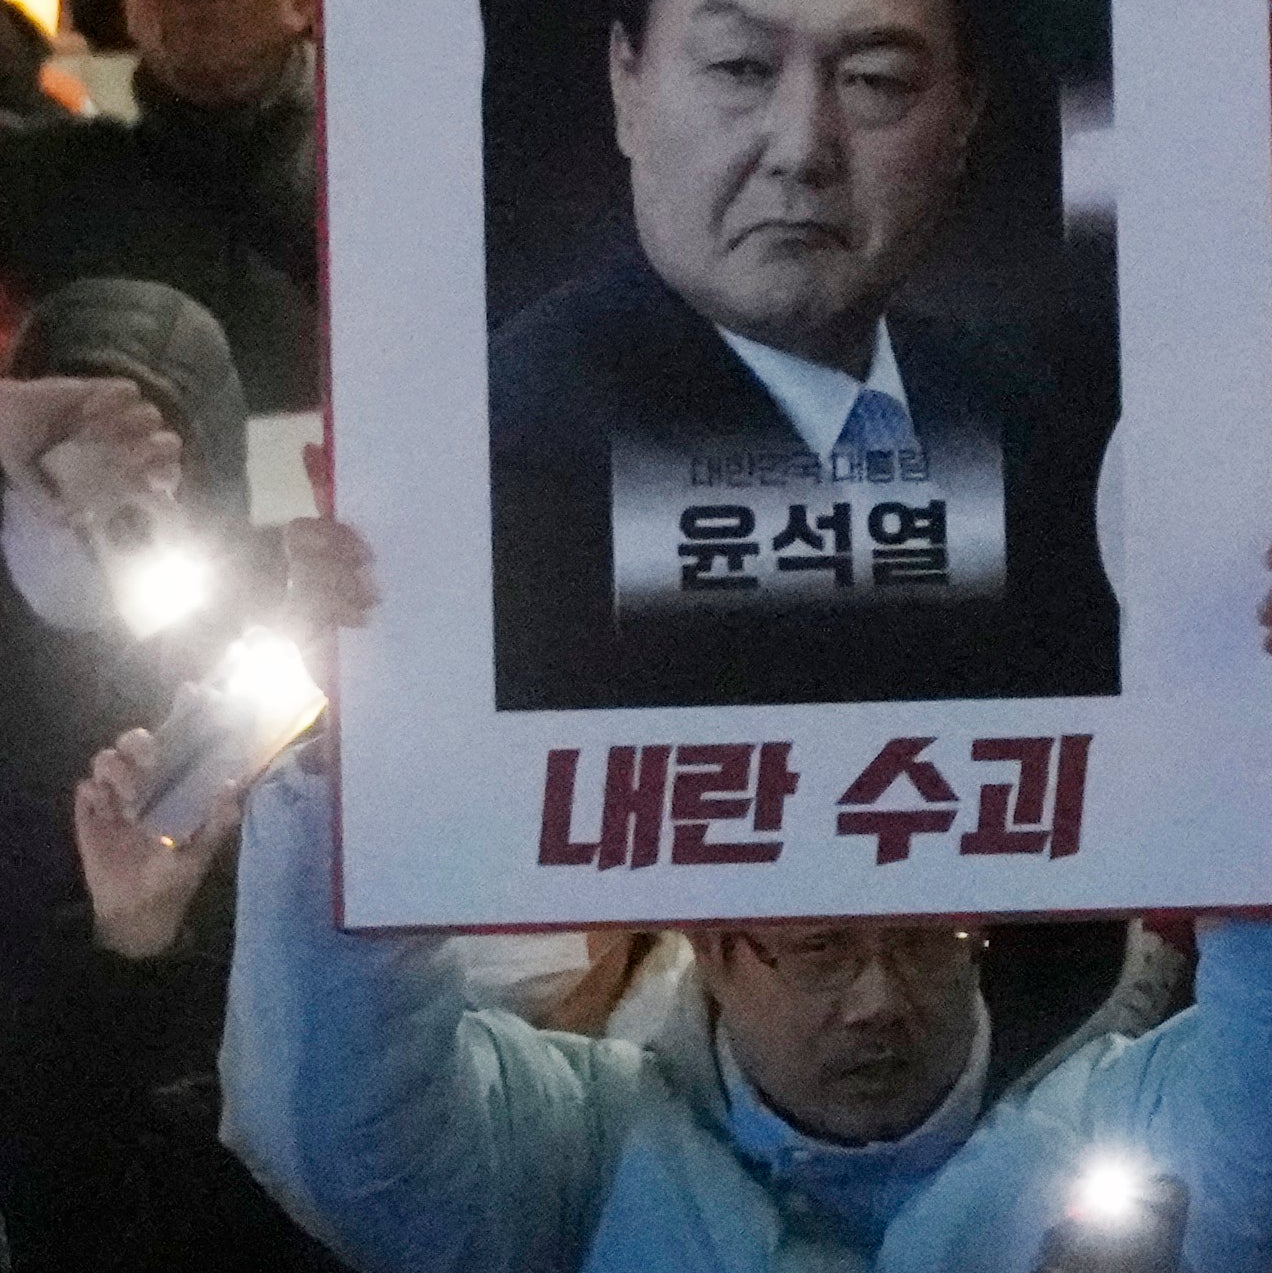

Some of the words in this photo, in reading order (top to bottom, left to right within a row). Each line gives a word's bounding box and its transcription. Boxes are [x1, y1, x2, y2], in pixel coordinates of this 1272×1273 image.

[677, 499, 949, 591] 윤석열
[538, 740, 800, 871] 내란
[835, 733, 1095, 865] 수괴
